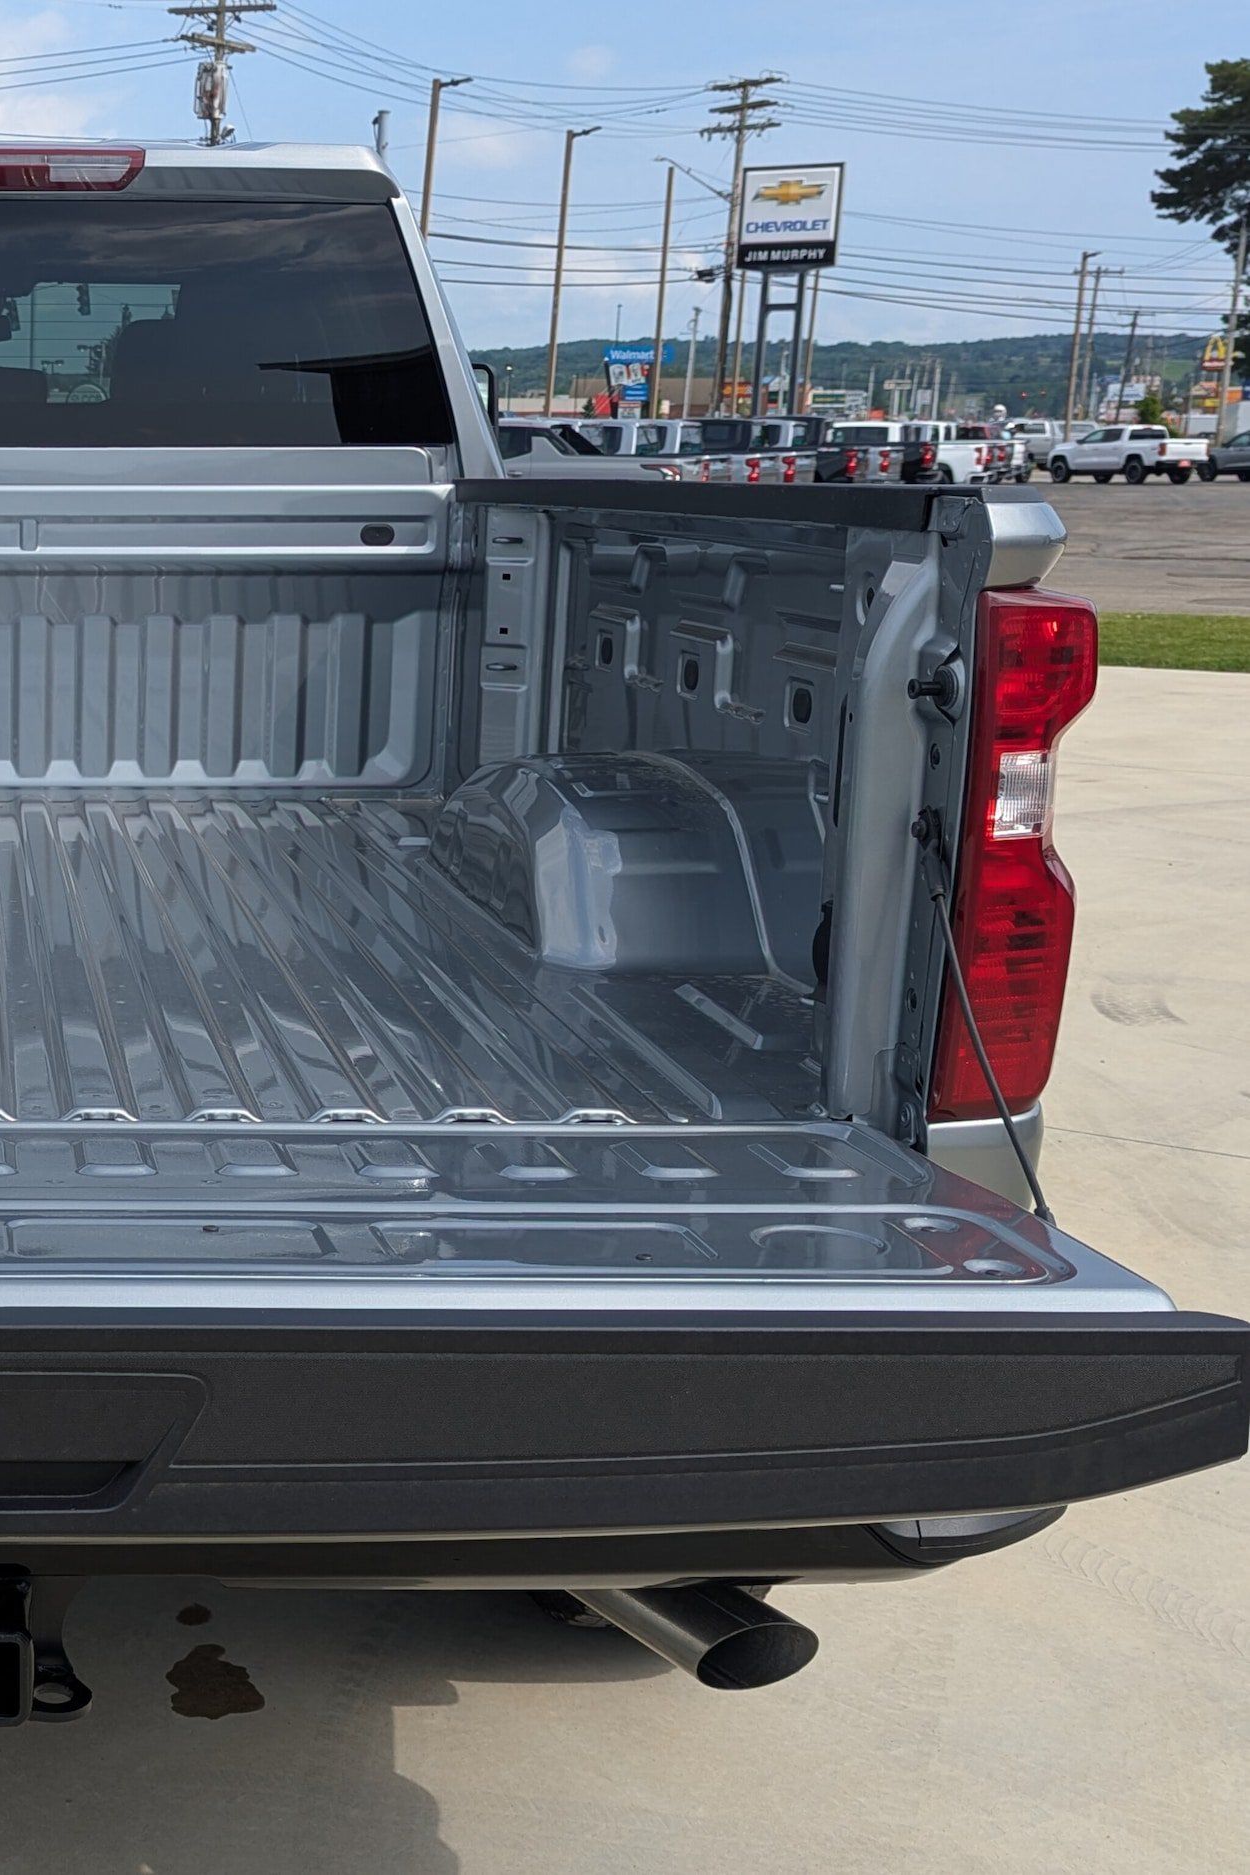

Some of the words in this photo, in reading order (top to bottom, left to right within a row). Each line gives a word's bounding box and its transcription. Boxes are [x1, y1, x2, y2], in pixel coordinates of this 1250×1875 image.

[745, 219, 830, 234] CHEVROLET
[744, 249, 769, 262] JIM
[770, 248, 827, 261] MURPHY
